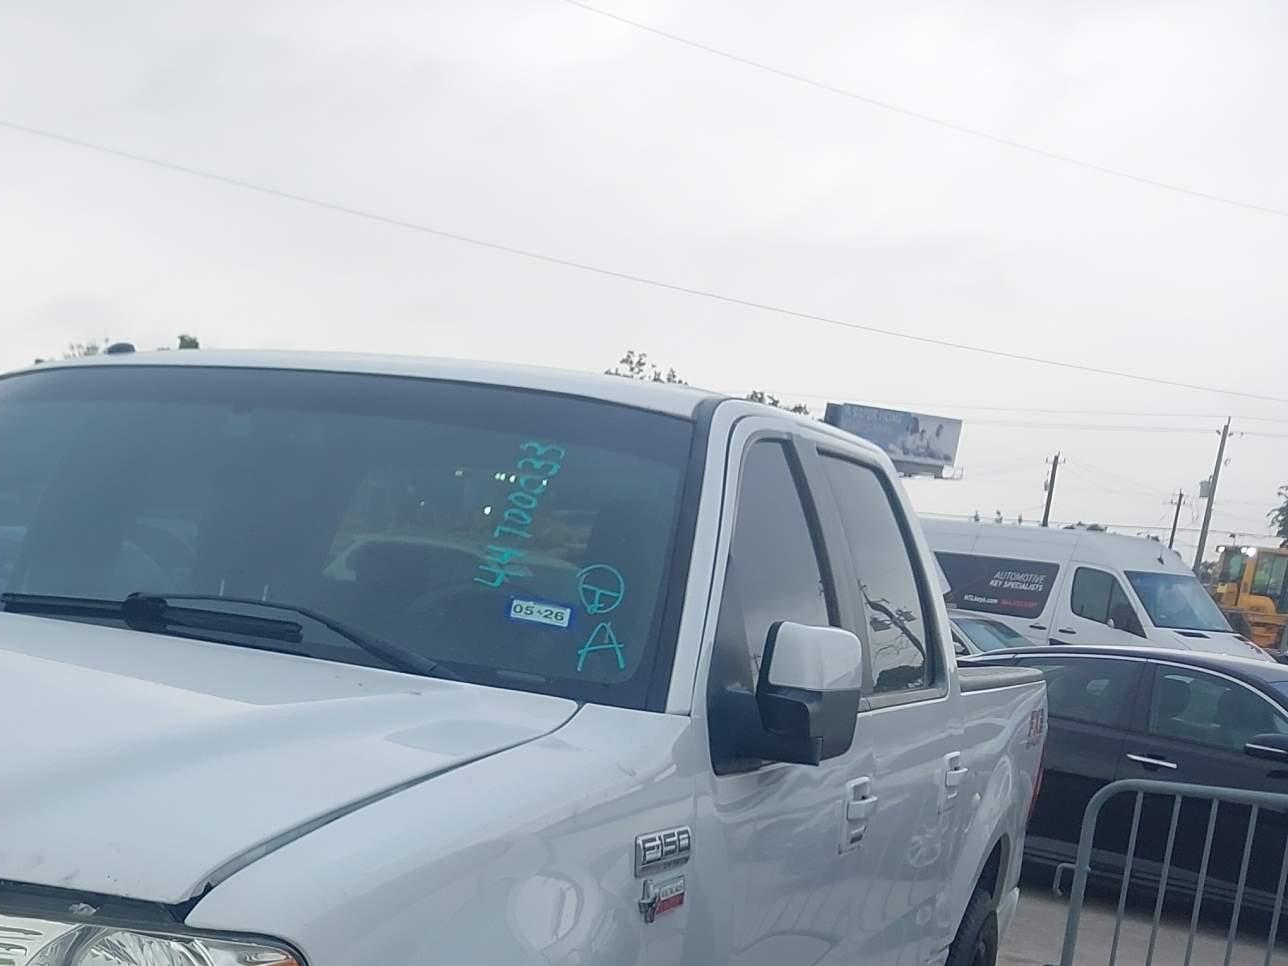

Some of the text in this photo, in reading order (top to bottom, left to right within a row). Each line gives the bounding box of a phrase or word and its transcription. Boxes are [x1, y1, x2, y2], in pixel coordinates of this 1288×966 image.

[474, 442, 565, 587] 44700033
[989, 579, 1044, 592] KEY SPECIALISTS
[993, 571, 1048, 584] AUTOMOTIVE
[513, 603, 564, 622] 05 26
[577, 622, 624, 672] A
